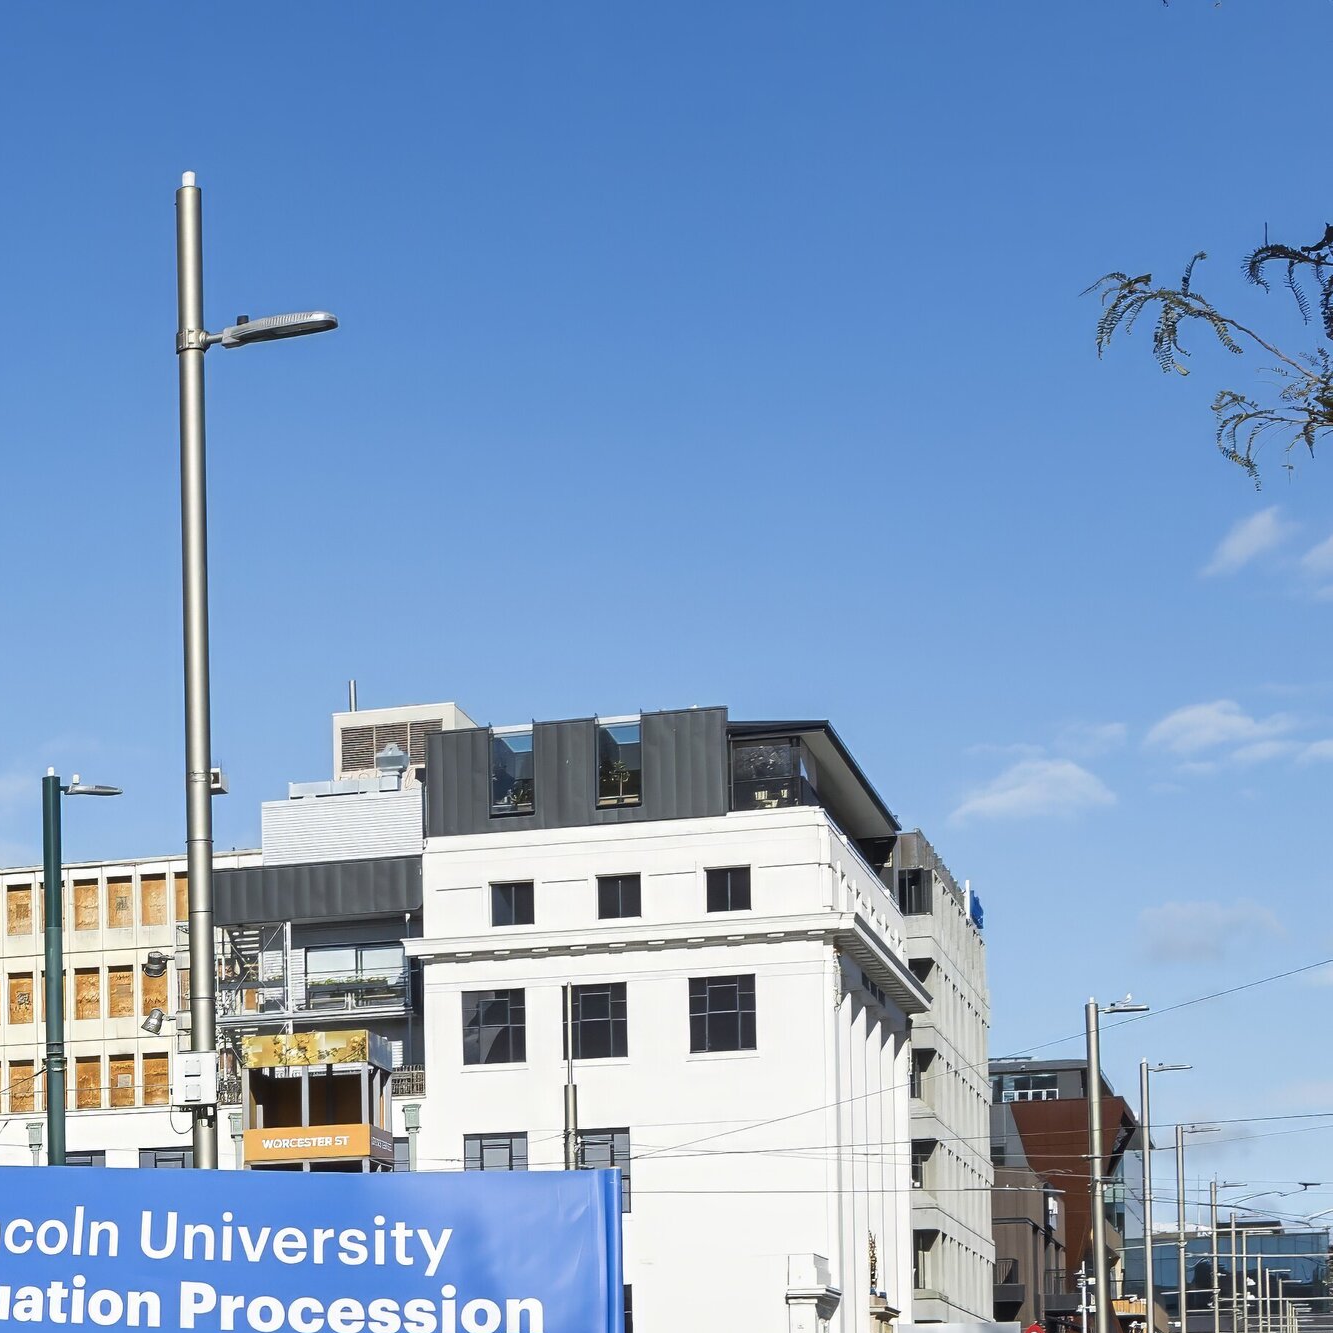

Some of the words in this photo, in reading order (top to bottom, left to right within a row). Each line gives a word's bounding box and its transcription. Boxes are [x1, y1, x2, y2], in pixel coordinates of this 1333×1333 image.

[262, 1137, 332, 1149] WORCESTER
[334, 1136, 350, 1146] ST
[140, 1211, 453, 1276] University
